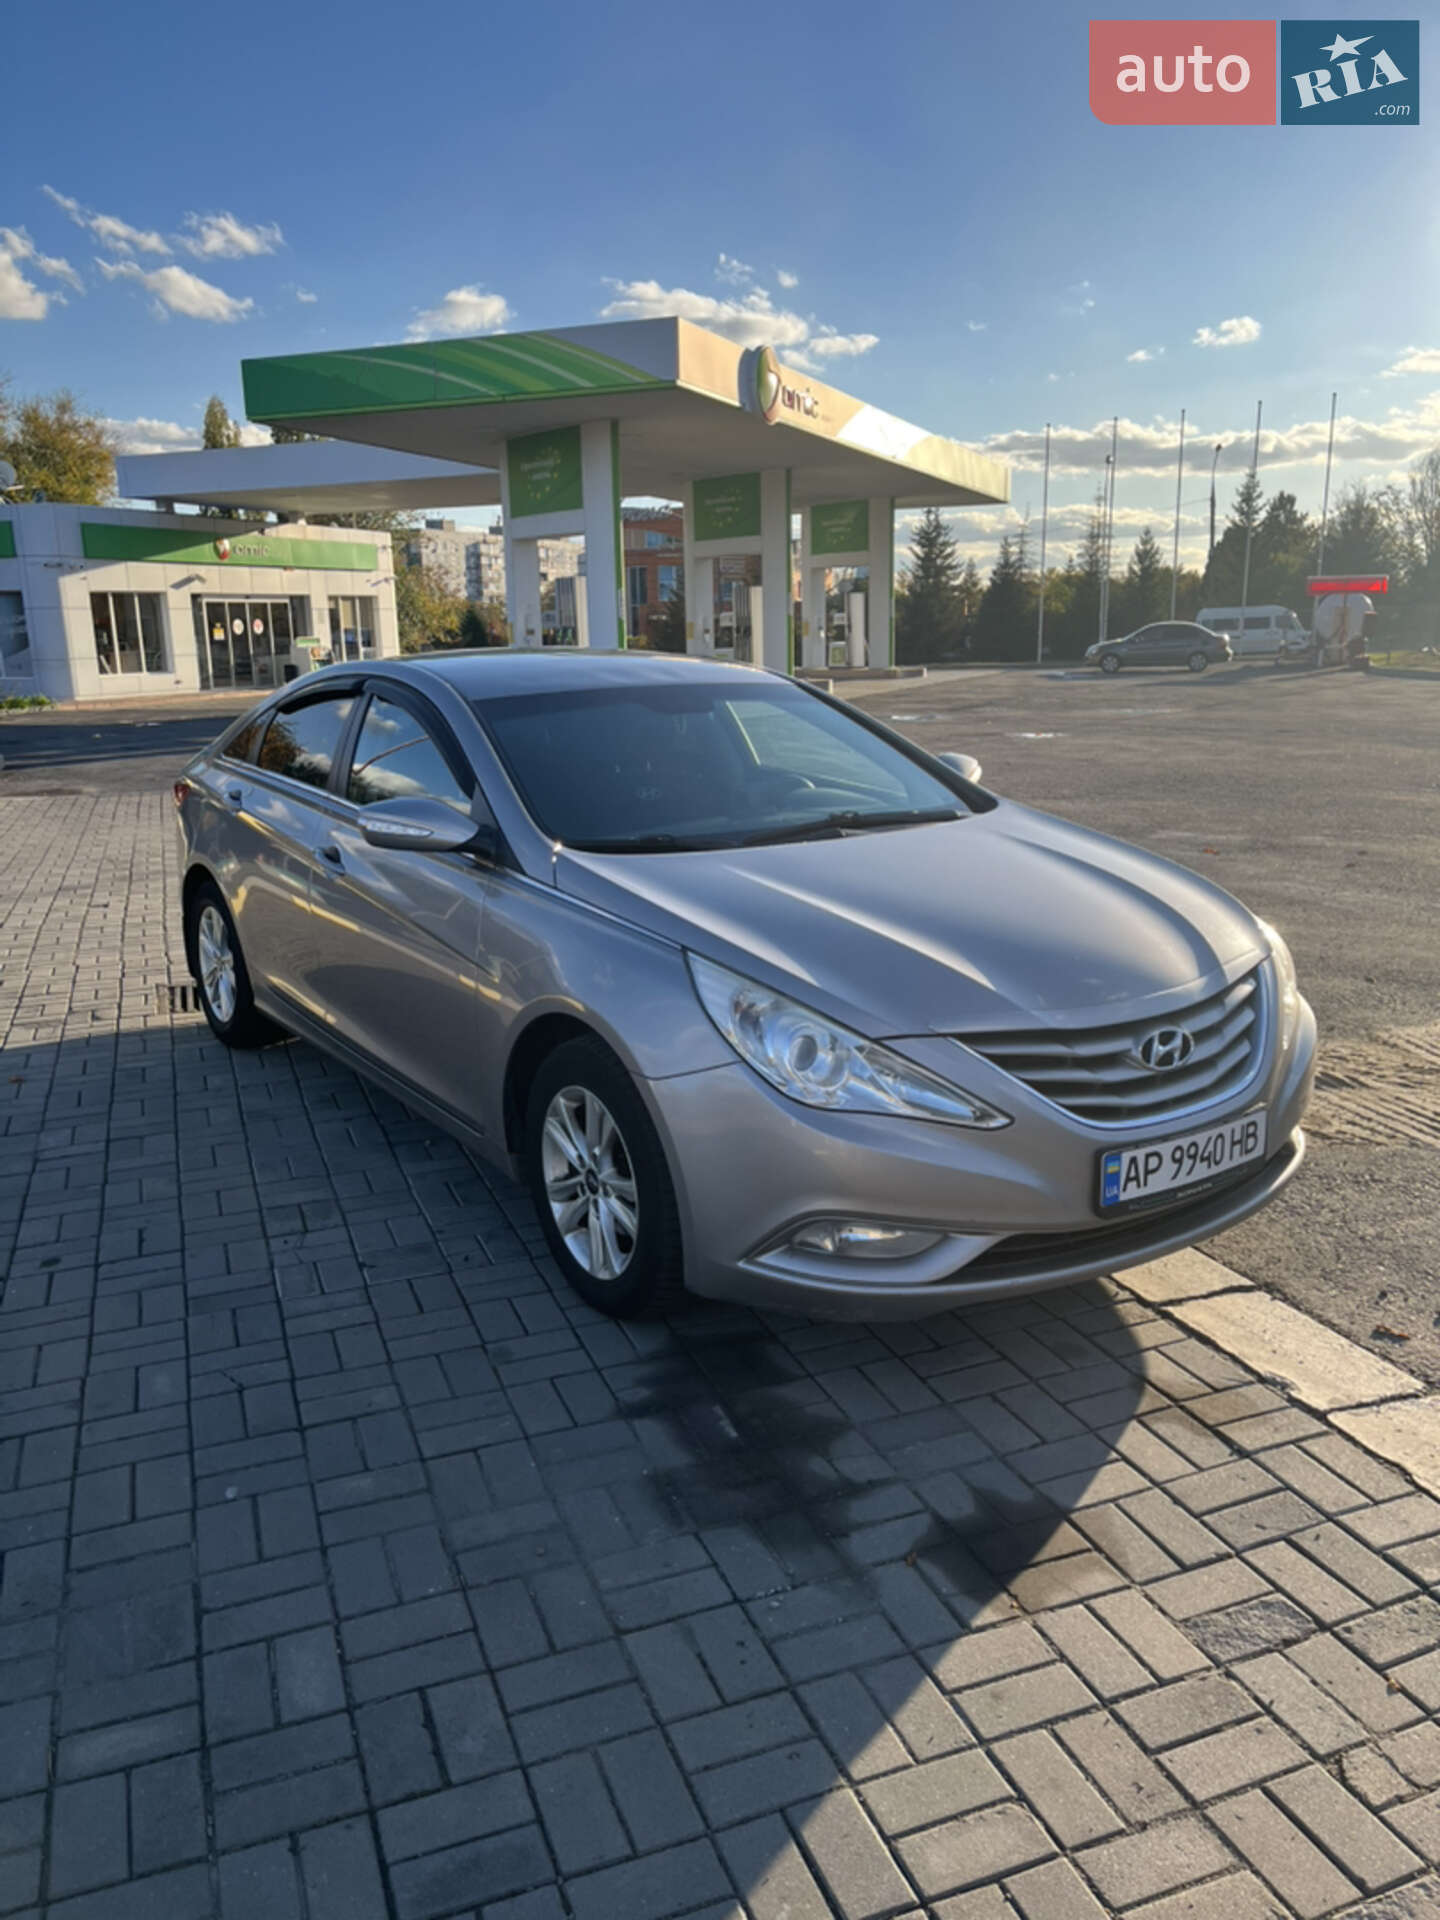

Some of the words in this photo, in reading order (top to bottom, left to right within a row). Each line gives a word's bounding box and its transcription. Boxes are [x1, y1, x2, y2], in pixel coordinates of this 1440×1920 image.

[1122, 1150, 1164, 1193] AP
[1171, 1131, 1226, 1181] 9940
[1229, 1119, 1259, 1162] HB
